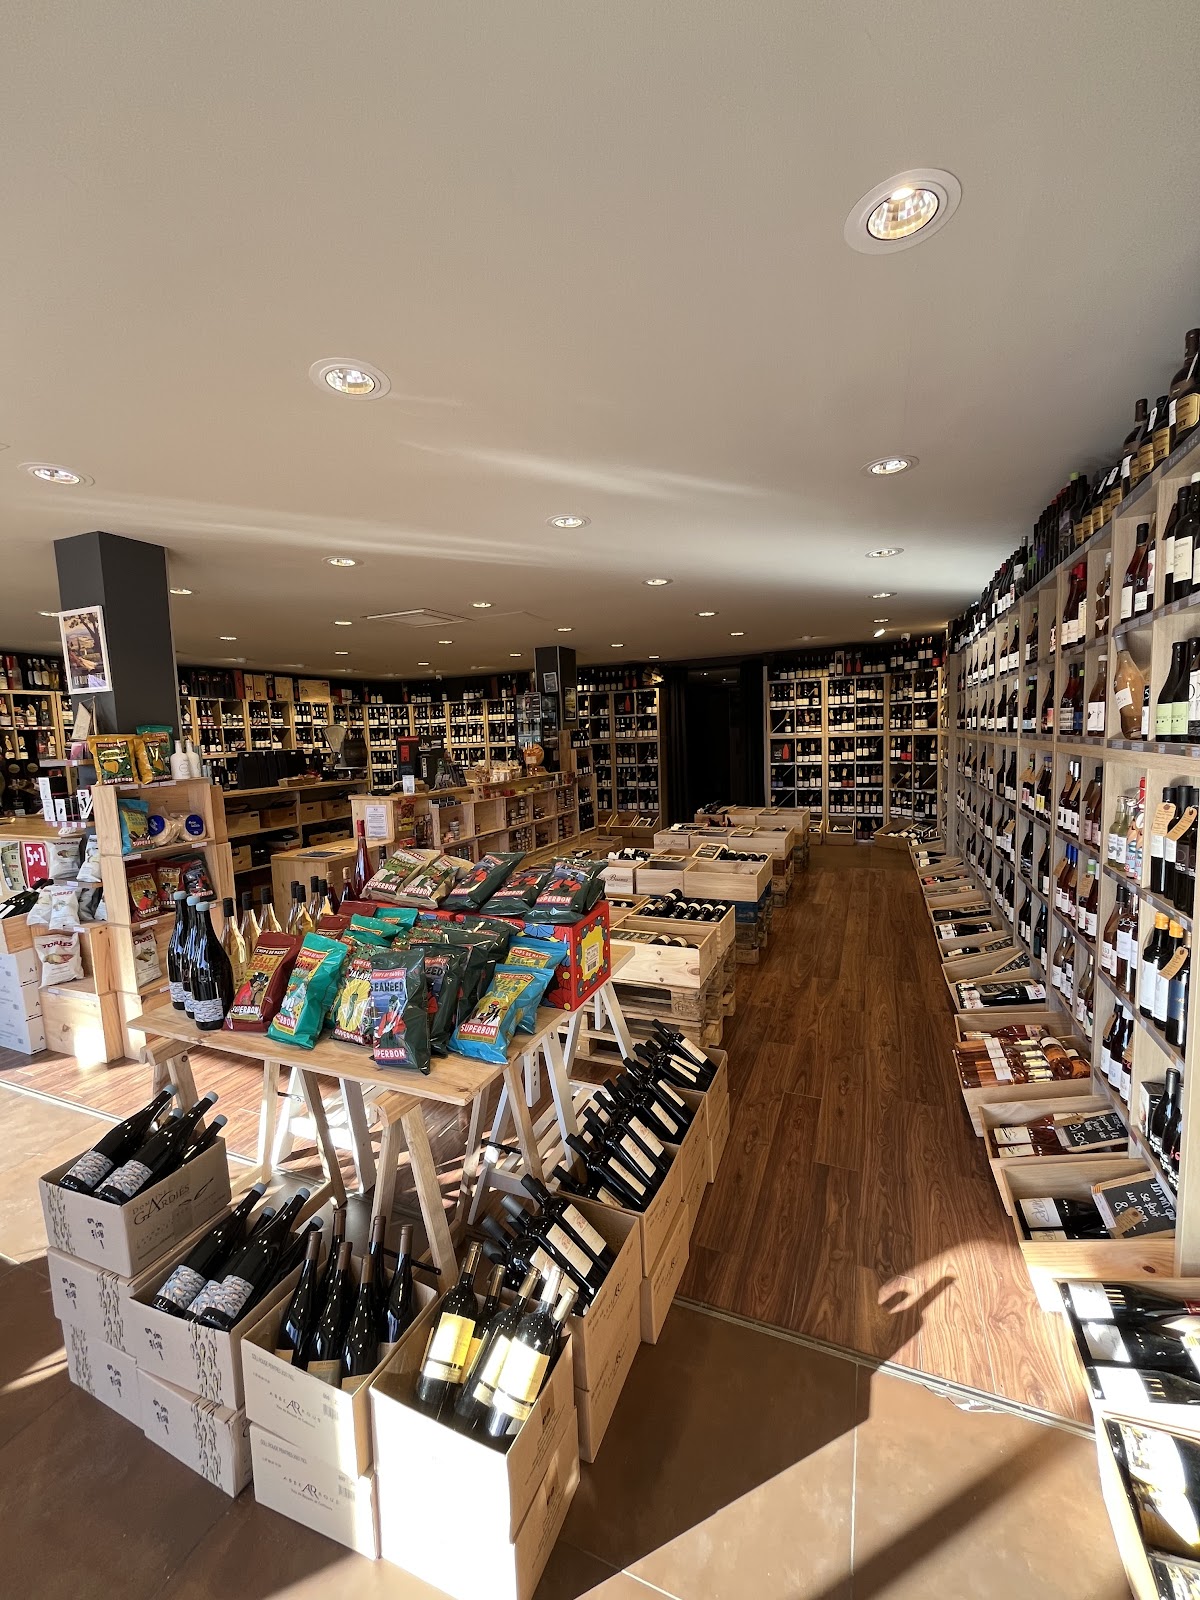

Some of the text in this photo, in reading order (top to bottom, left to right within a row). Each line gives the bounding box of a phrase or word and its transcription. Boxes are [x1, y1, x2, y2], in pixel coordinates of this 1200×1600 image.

[103, 777, 134, 785] SUPERBON
[25, 846, 47, 867] 5+1
[367, 881, 397, 892] SUPERBON
[403, 886, 432, 896] SUPERBON
[537, 896, 572, 904] SUPERBON
[42, 940, 73, 949] TORRES
[133, 934, 154, 946] ORRES
[512, 948, 526, 956] CHIPS
[254, 955, 271, 963] SALT
[371, 981, 404, 993] SEAWEED
[230, 1005, 261, 1015] SUPERBON
[460, 1023, 496, 1036] SUPERBON
[373, 1048, 405, 1059] UPERBON
[1125, 1191, 1138, 1205] un
[1139, 1192, 1159, 1219] se fait
